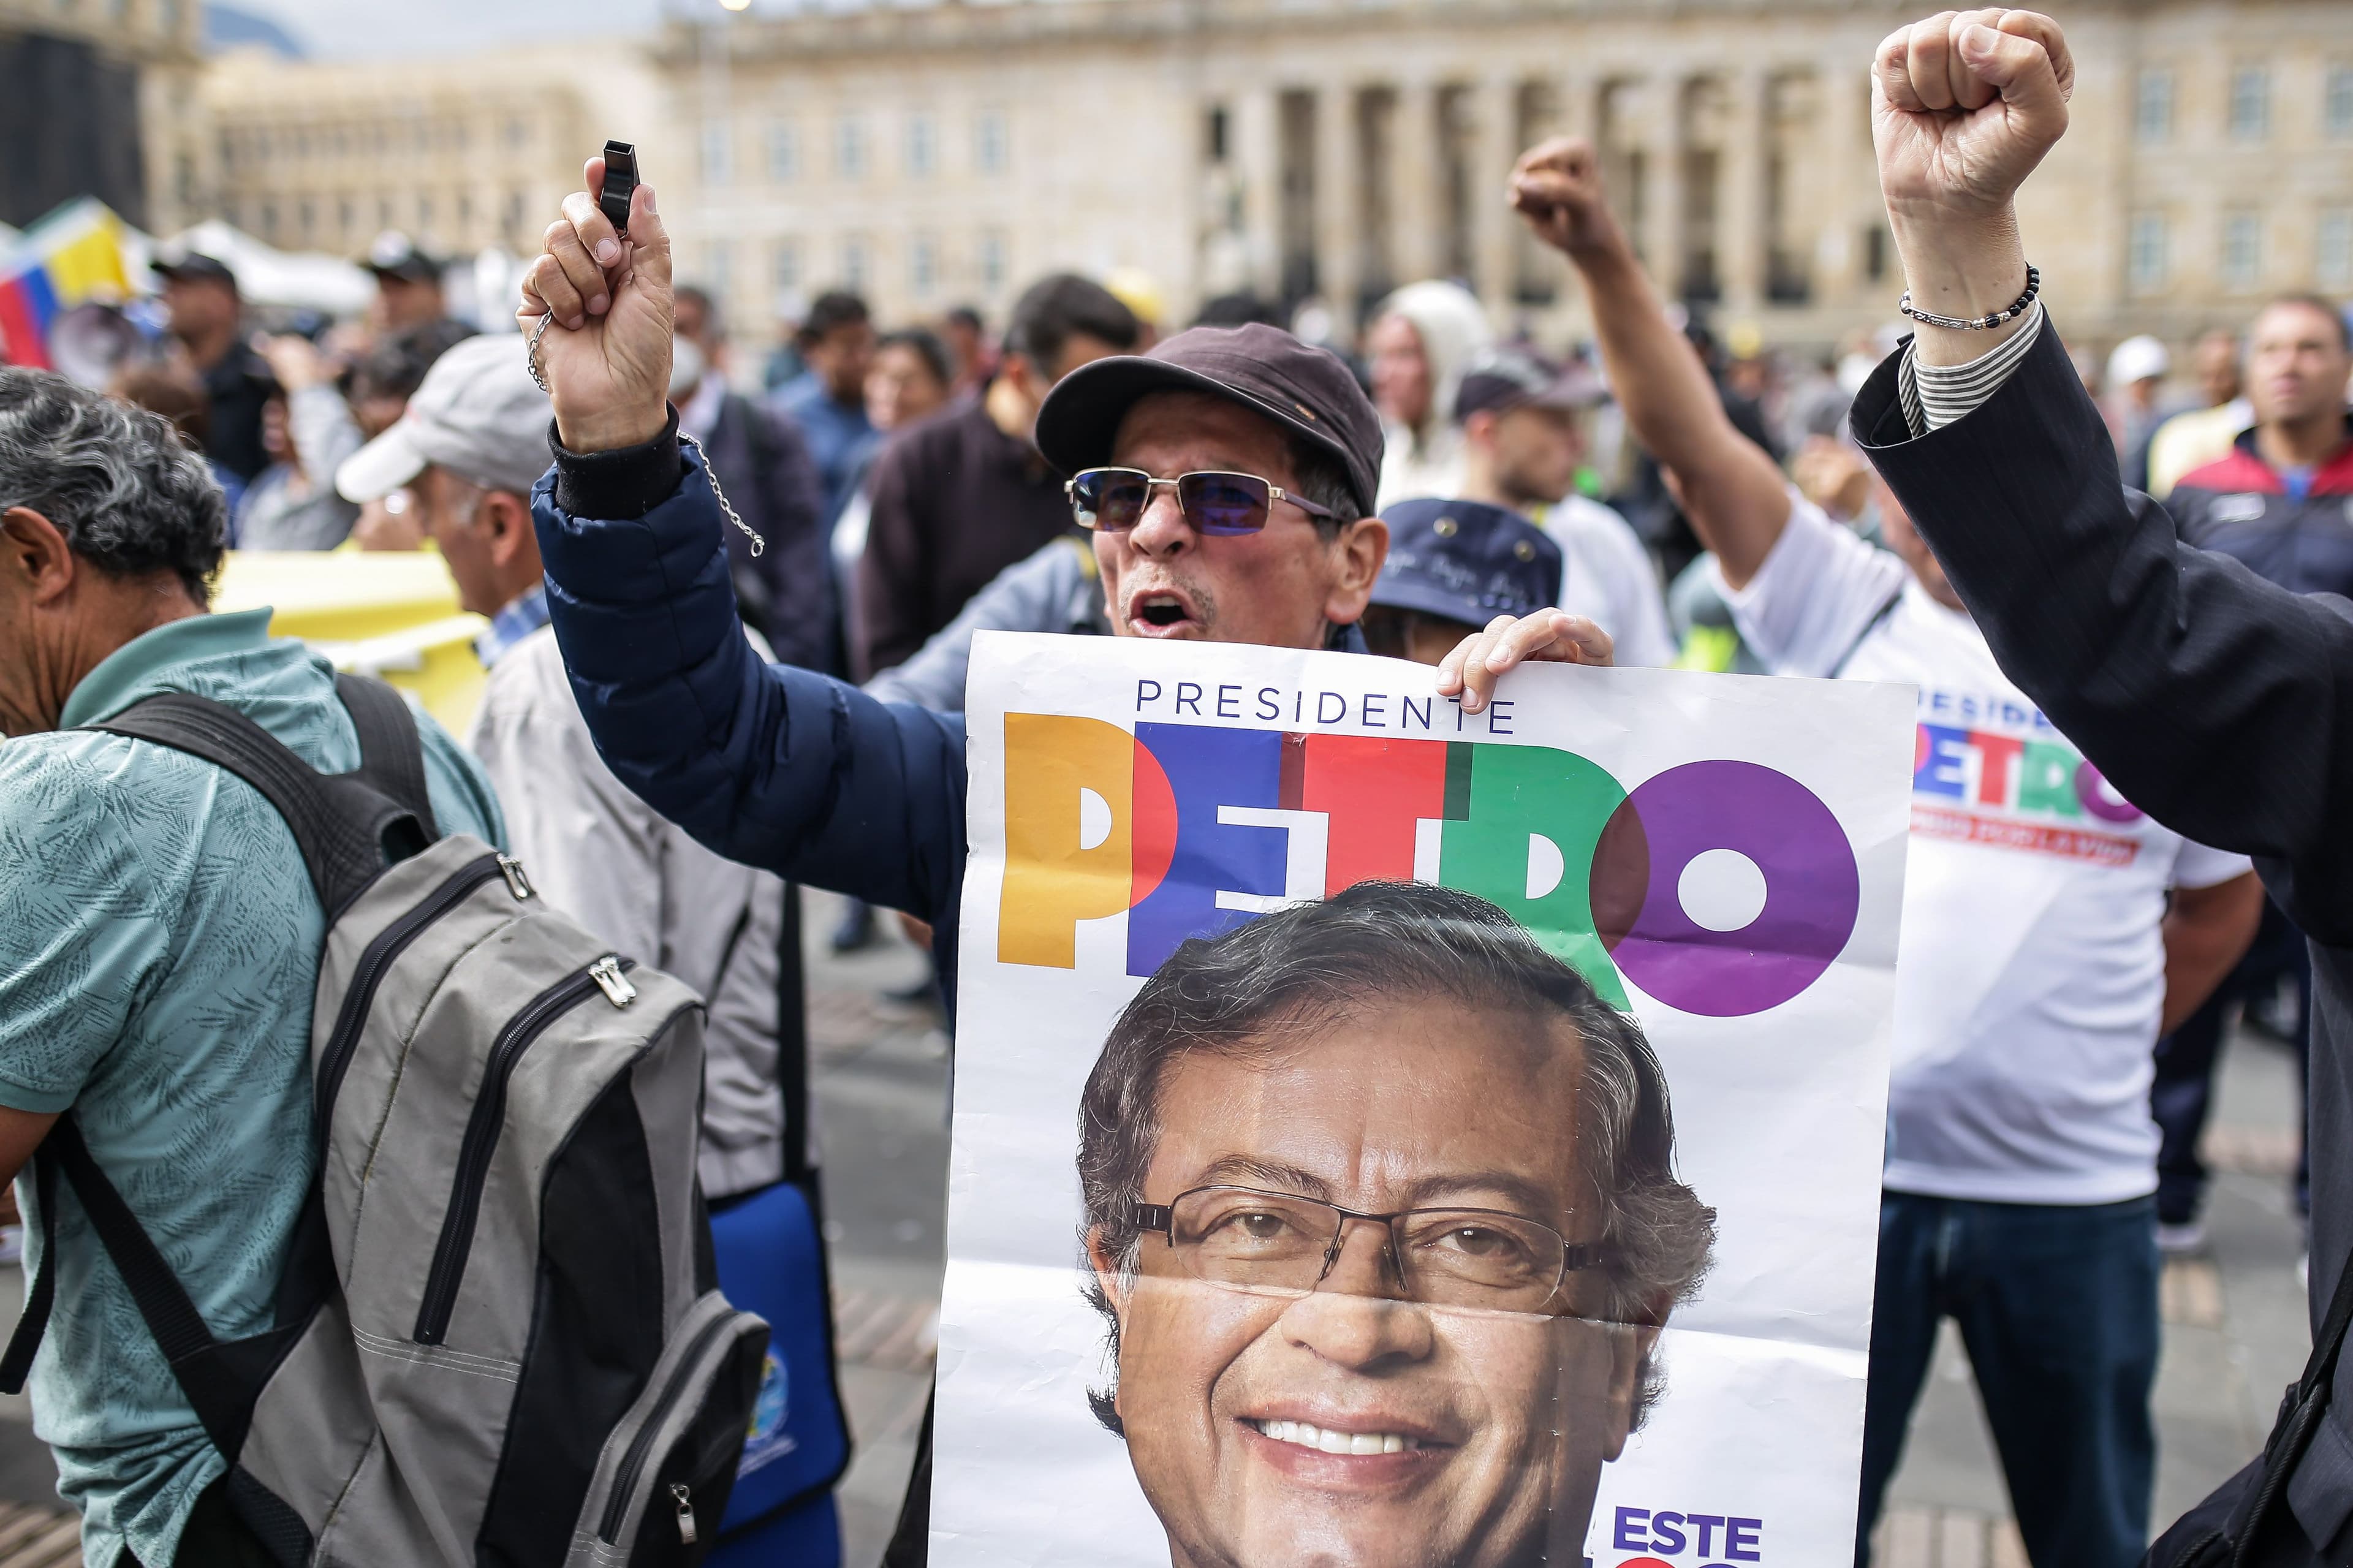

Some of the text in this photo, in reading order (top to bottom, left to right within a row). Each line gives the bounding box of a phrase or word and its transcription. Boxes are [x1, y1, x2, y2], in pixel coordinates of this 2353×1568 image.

[1137, 680, 1515, 735] PRESIDENTE
[1912, 722, 2146, 824] ETRO
[996, 711, 1860, 1018] PETRO
[1613, 1506, 1762, 1562] ESTE
